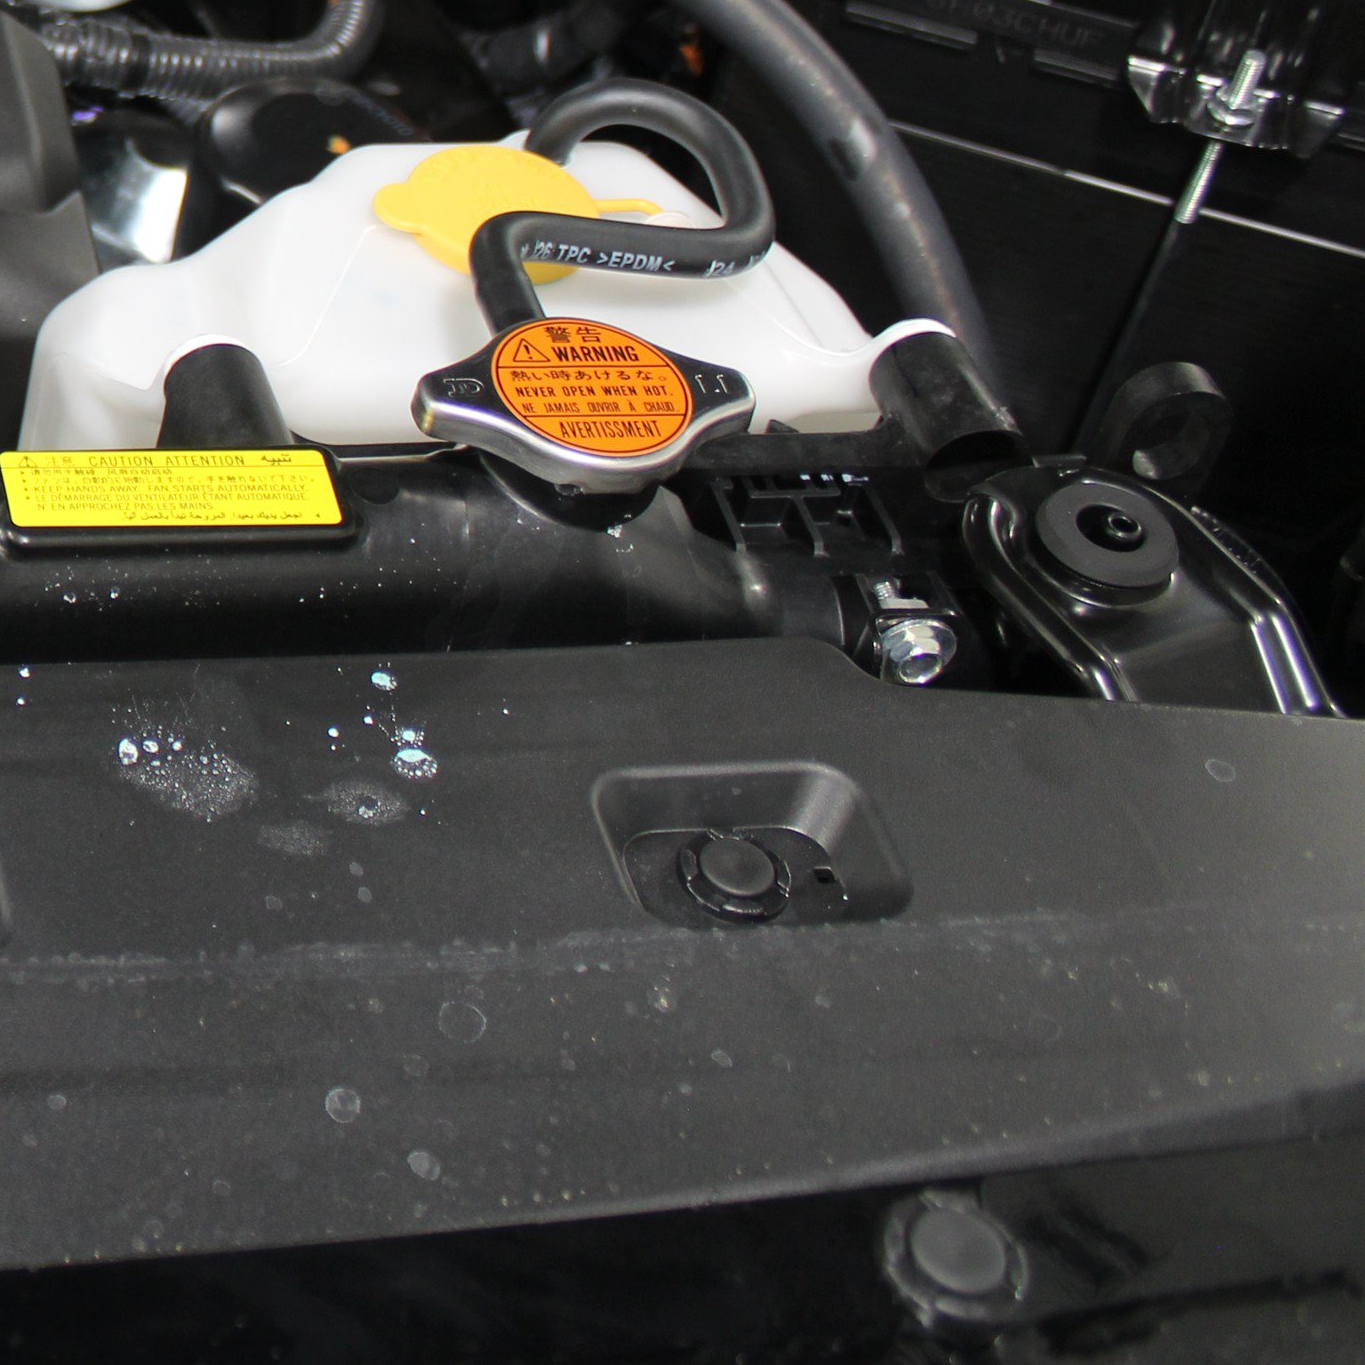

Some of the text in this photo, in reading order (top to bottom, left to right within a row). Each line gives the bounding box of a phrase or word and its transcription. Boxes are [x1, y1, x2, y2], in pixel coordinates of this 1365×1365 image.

[557, 244, 592, 264] TPC
[543, 326, 602, 344] 警告
[551, 346, 640, 362] WARNING
[515, 385, 674, 398] NEVER OPEN WHEN HOT.
[521, 403, 537, 413] NE
[543, 402, 580, 413] JAMAIS
[586, 401, 621, 413] OUVRIR
[627, 398, 637, 413] À
[559, 420, 662, 439] AVERTISSMENT
[88, 455, 154, 468] CAUTION
[165, 455, 246, 466] ATTENTION
[34, 485, 63, 494] KEEP
[66, 485, 106, 493] HANDS
[148, 484, 170, 493] FAN
[172, 484, 215, 493] STARTS
[35, 494, 47, 502] LE
[51, 493, 112, 502] DÉMARRAGE
[115, 493, 130, 502] DU
[132, 493, 199, 502] VENTILATEUR
[202, 491, 233, 502] ÉTANT
[68, 502, 130, 511] APPROCHEZ
[133, 502, 154, 511] PAS
[156, 502, 177, 511] LES
